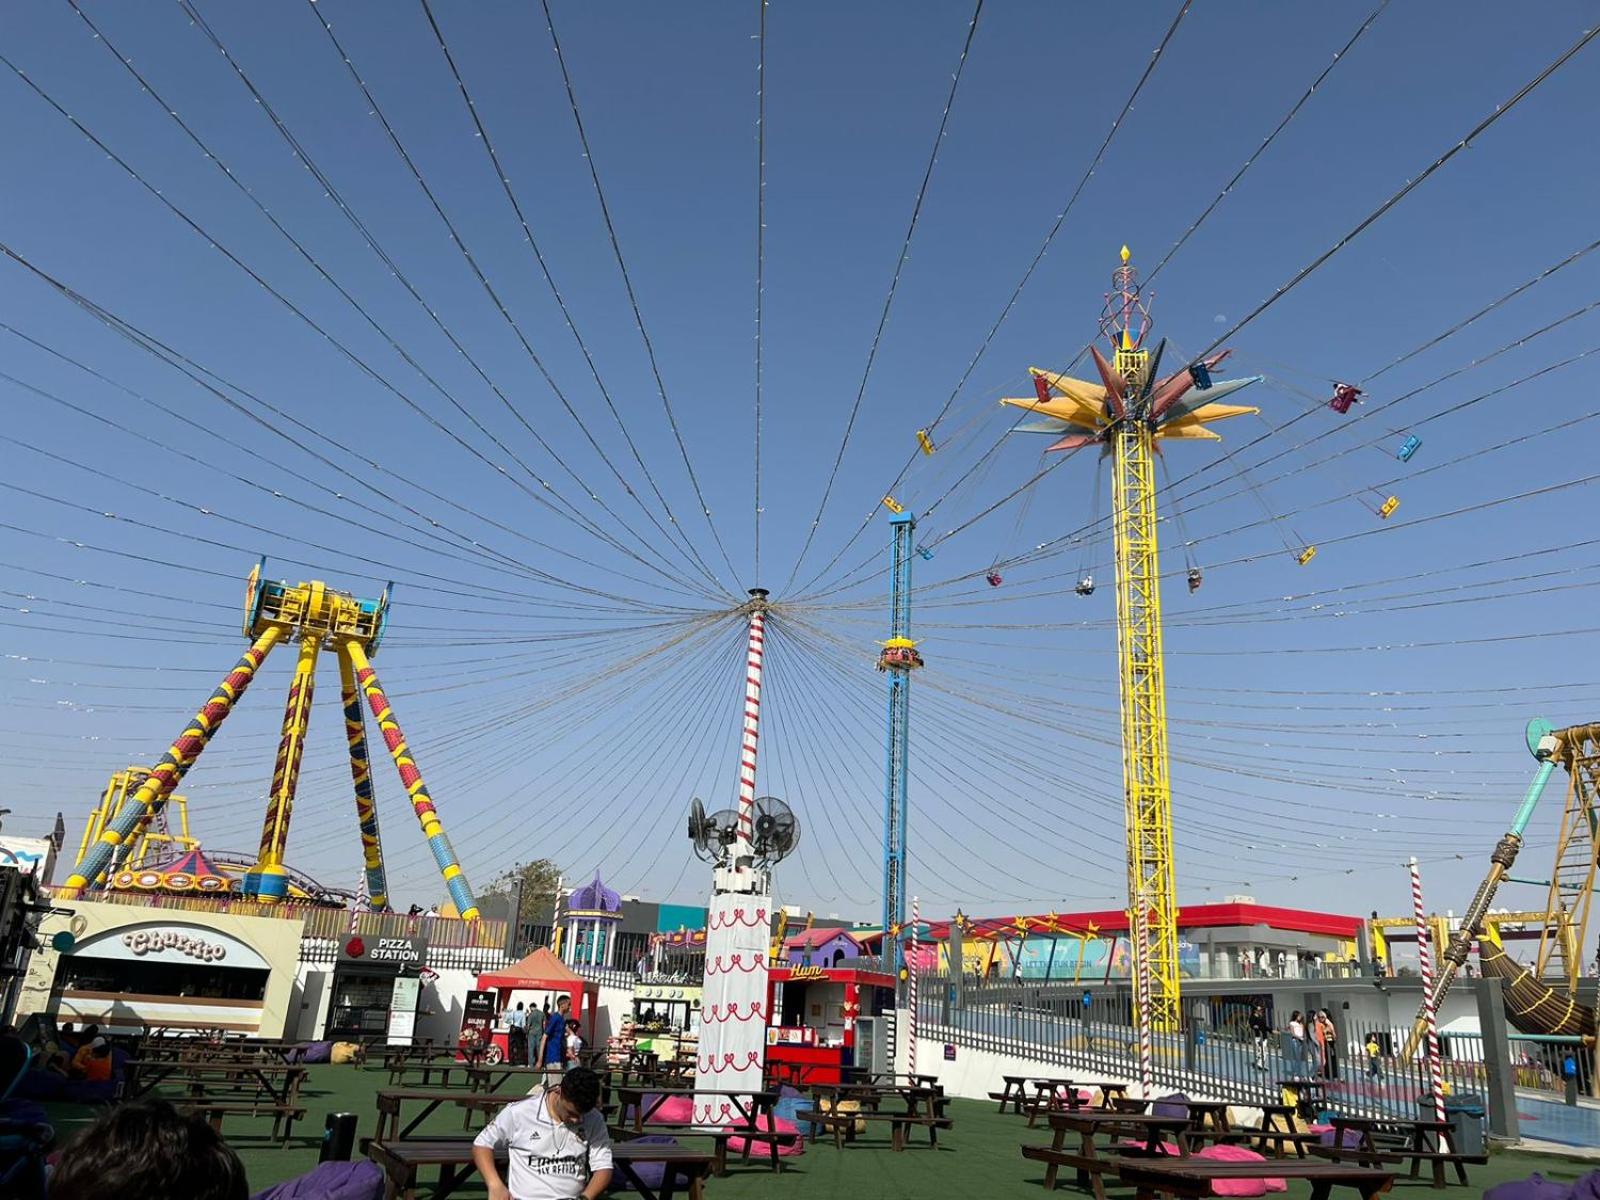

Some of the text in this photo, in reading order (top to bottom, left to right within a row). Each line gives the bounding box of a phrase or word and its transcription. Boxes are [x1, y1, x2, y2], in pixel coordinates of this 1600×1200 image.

[122, 930, 226, 962] Churrito
[378, 938, 413, 950] PIZZA
[370, 948, 420, 961] STATION
